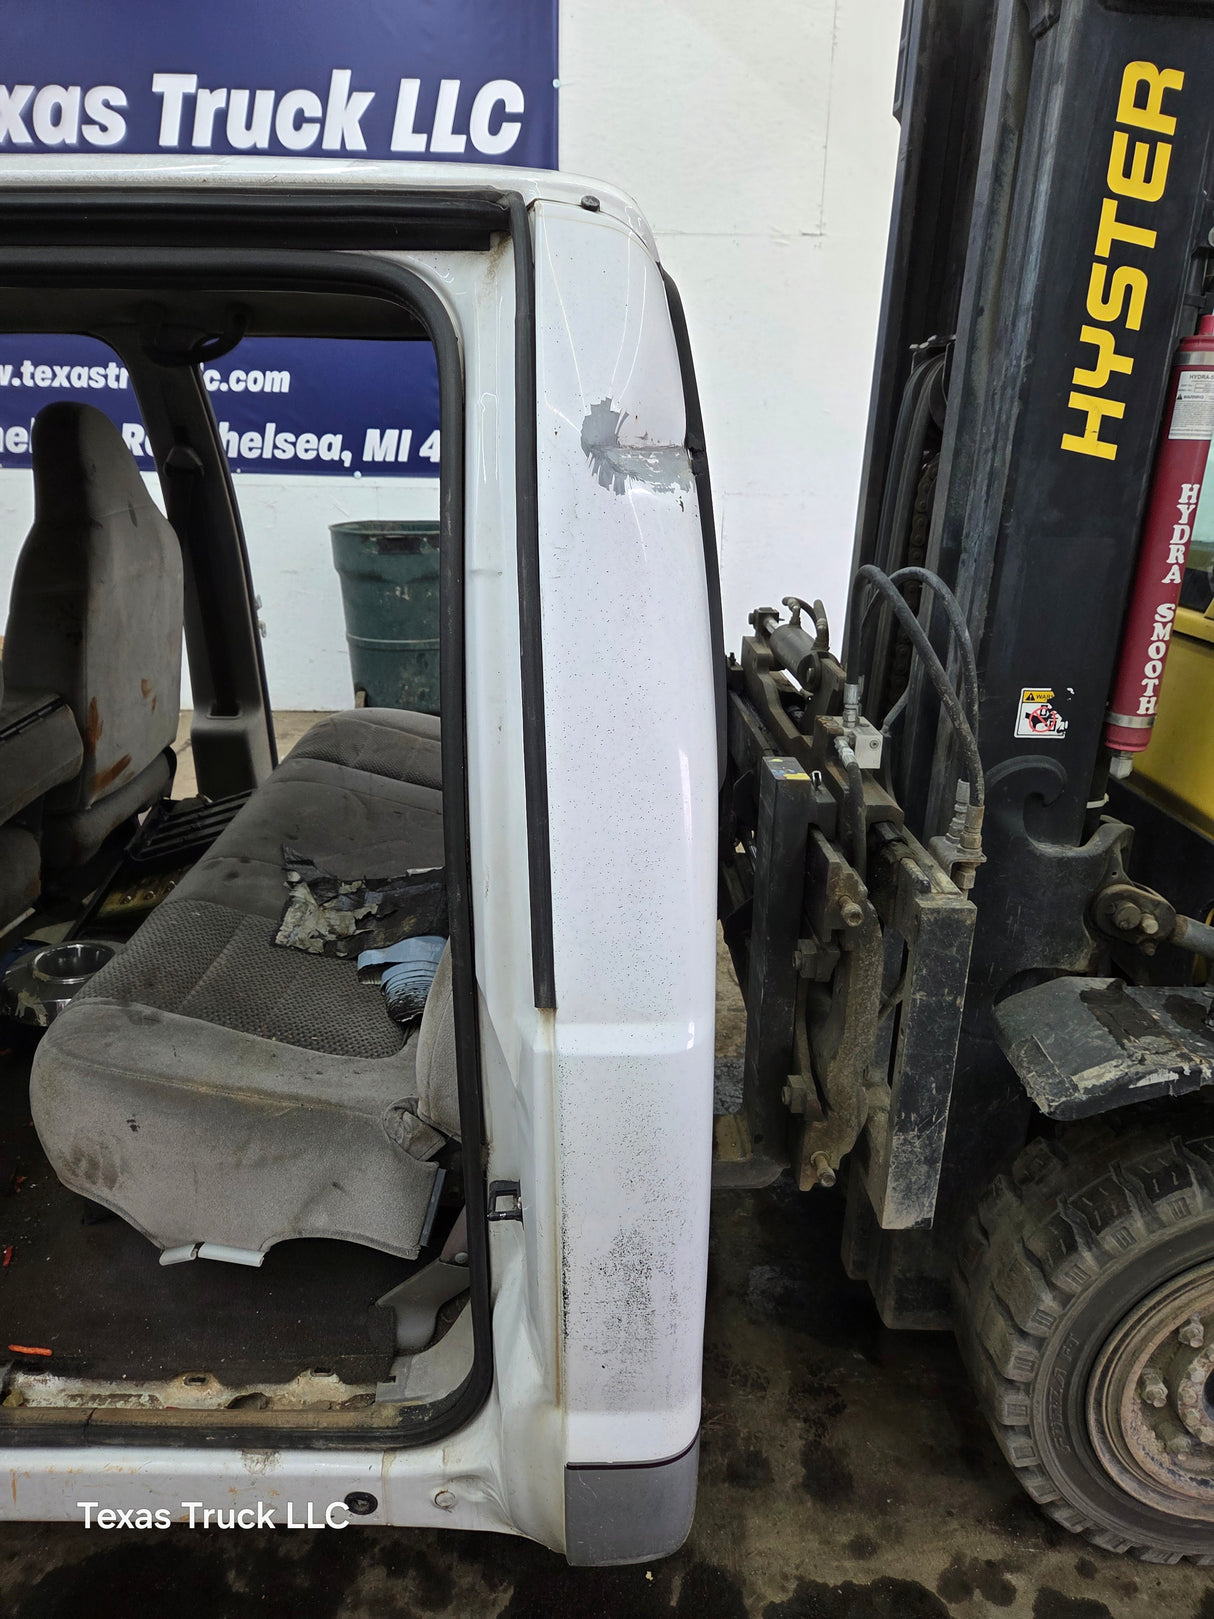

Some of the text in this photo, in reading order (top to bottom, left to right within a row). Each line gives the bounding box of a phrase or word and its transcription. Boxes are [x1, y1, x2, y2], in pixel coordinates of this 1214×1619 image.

[0, 69, 525, 154] xas Truck LLC
[1061, 60, 1185, 461] HYSTER
[219, 421, 353, 467] helsea,
[362, 428, 413, 462] MI
[1161, 483, 1200, 584] HYDRA
[1136, 603, 1176, 714] SMOOTH
